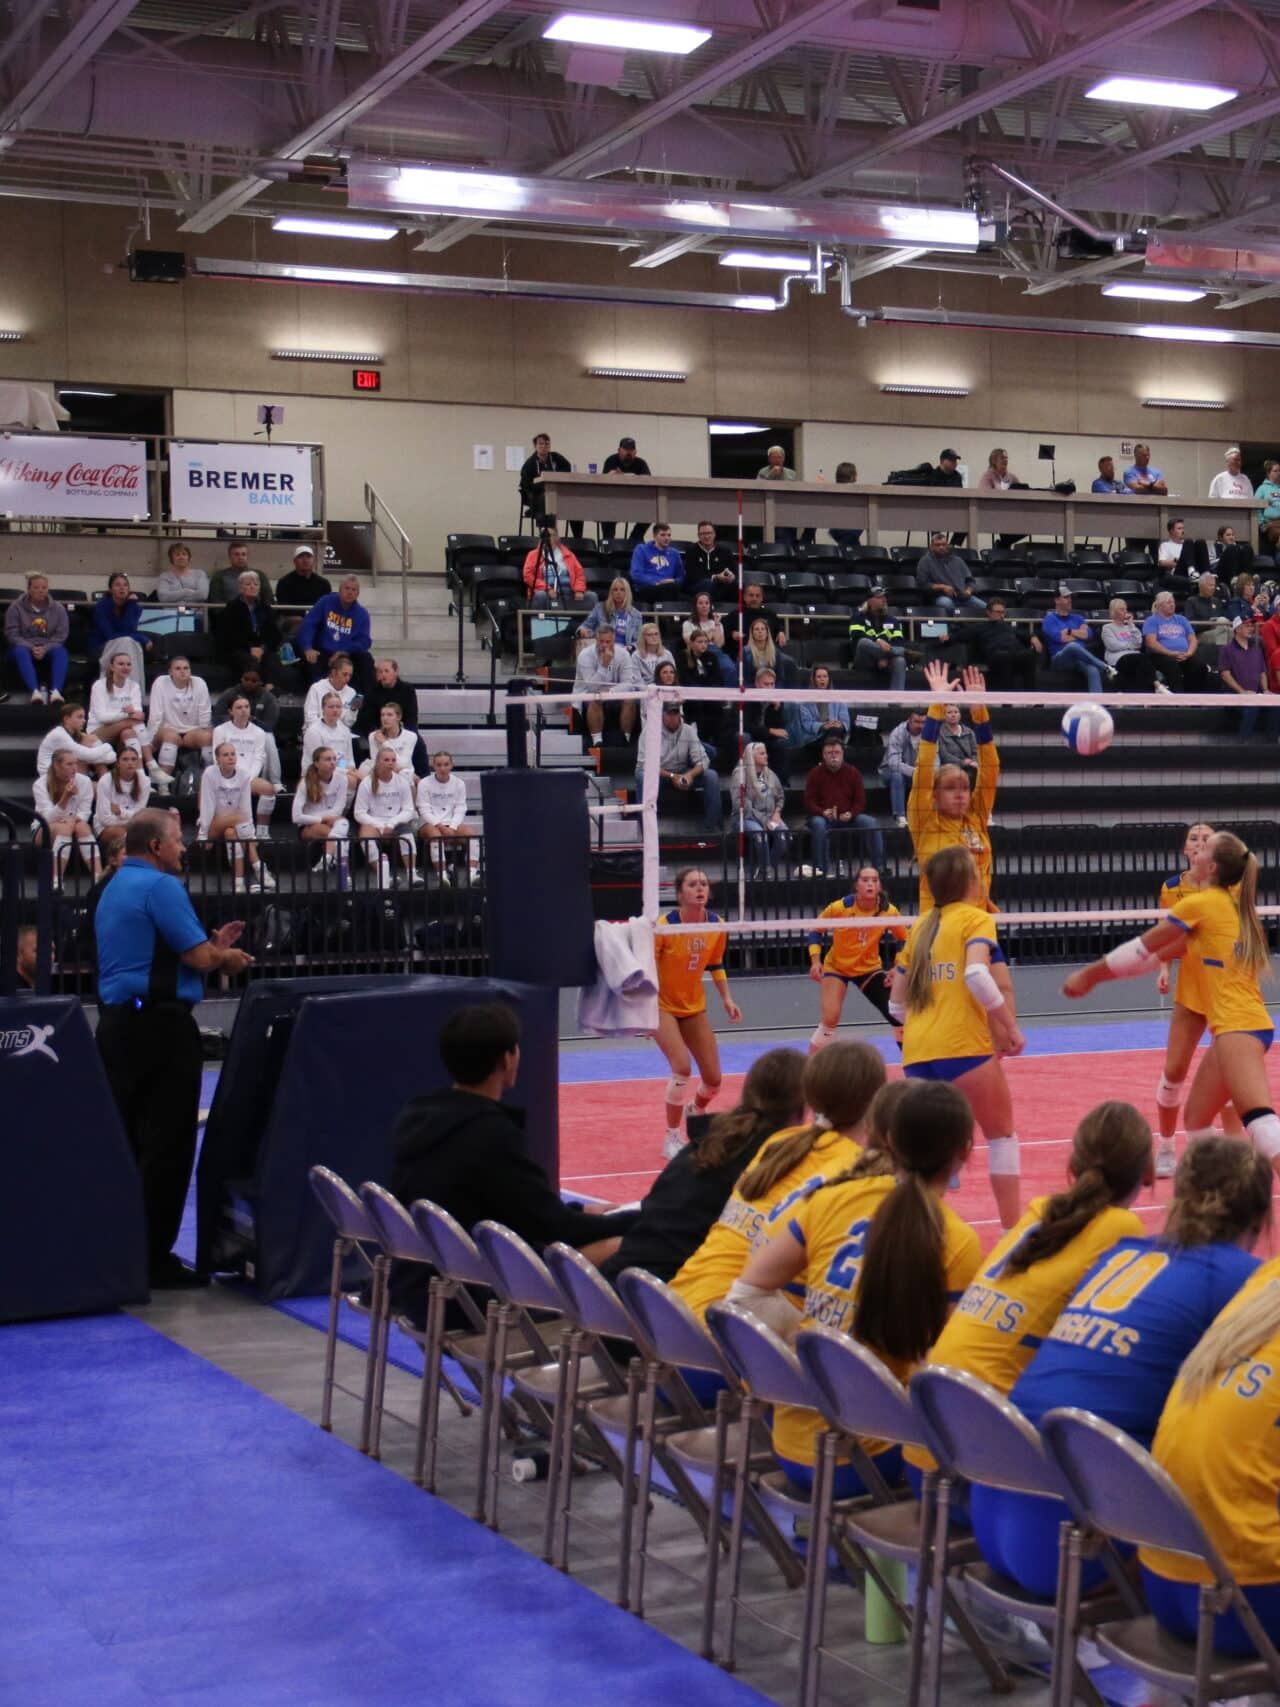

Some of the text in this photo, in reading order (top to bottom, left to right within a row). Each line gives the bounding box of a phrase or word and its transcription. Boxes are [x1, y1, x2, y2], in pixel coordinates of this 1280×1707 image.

[357, 371, 377, 388] EXIT
[188, 470, 295, 491] BREMER
[66, 489, 102, 497] BOTTLING
[248, 493, 295, 506] BANK
[1067, 1248, 1170, 1313] 10
